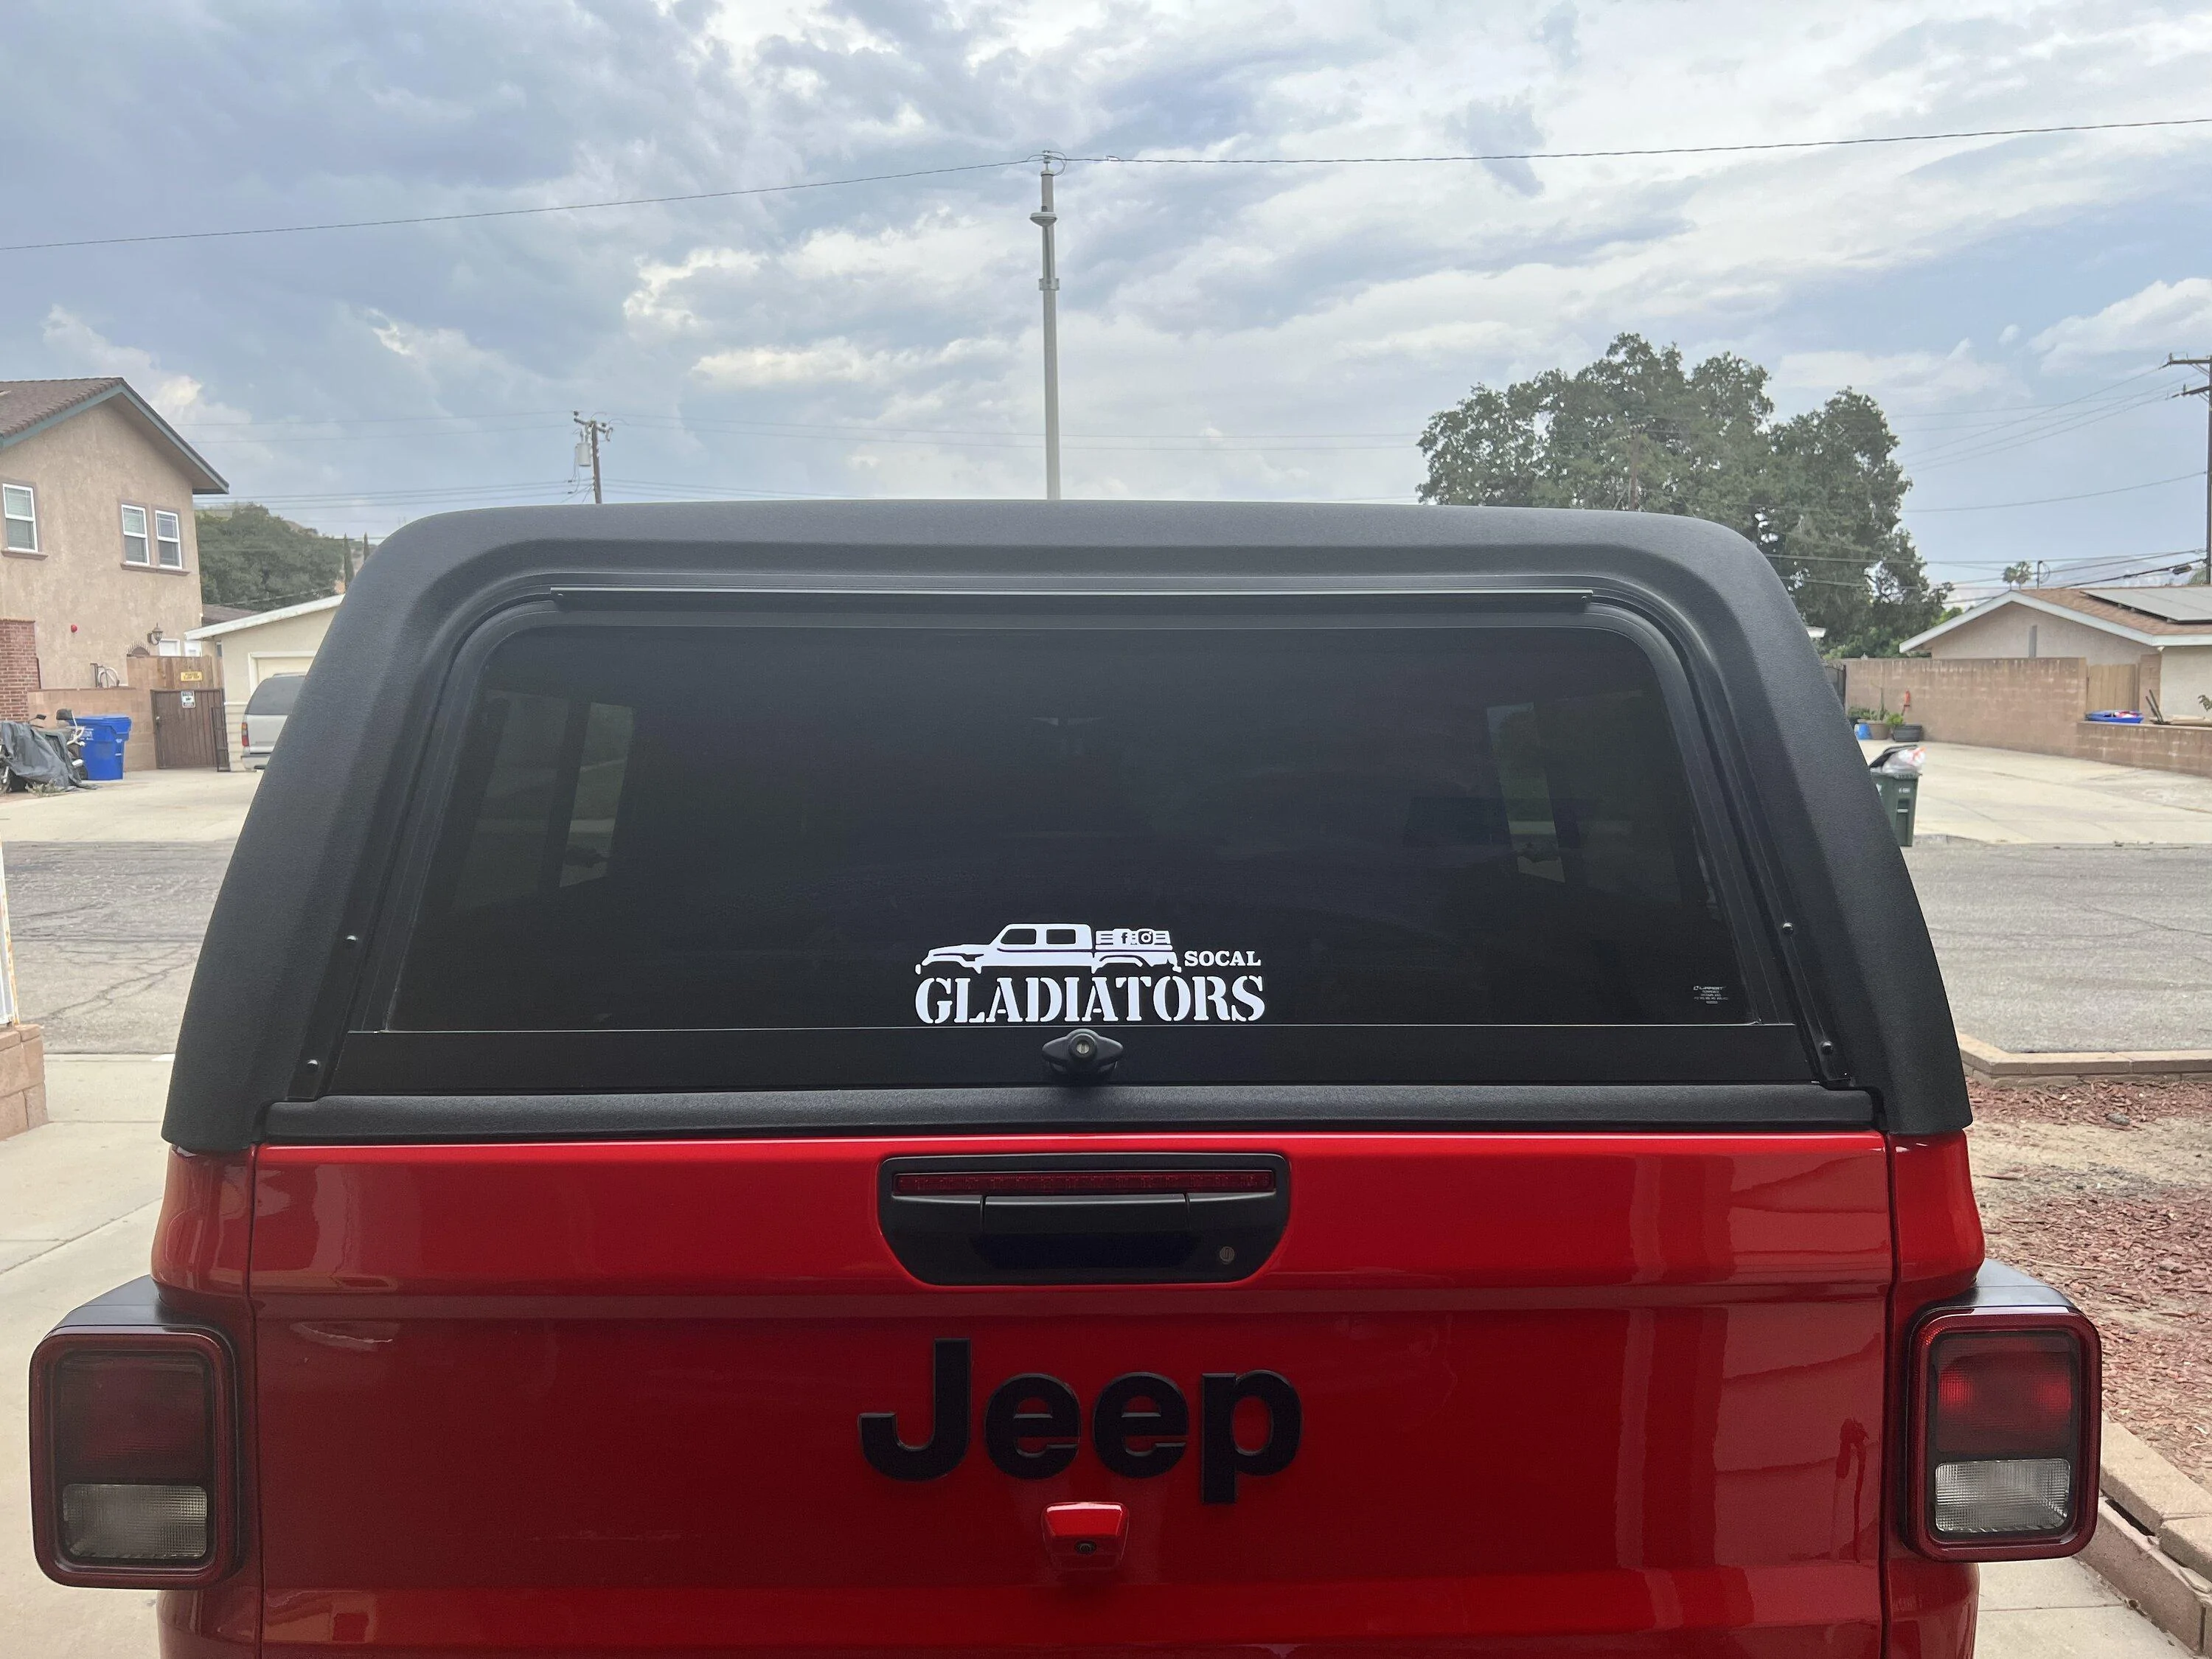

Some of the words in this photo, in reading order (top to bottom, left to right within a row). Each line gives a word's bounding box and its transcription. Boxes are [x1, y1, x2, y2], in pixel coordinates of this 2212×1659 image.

[1184, 950, 1262, 967] SOCAL
[915, 975, 1265, 1024] GLADIATORS
[858, 1338, 1302, 1504] Jeep
